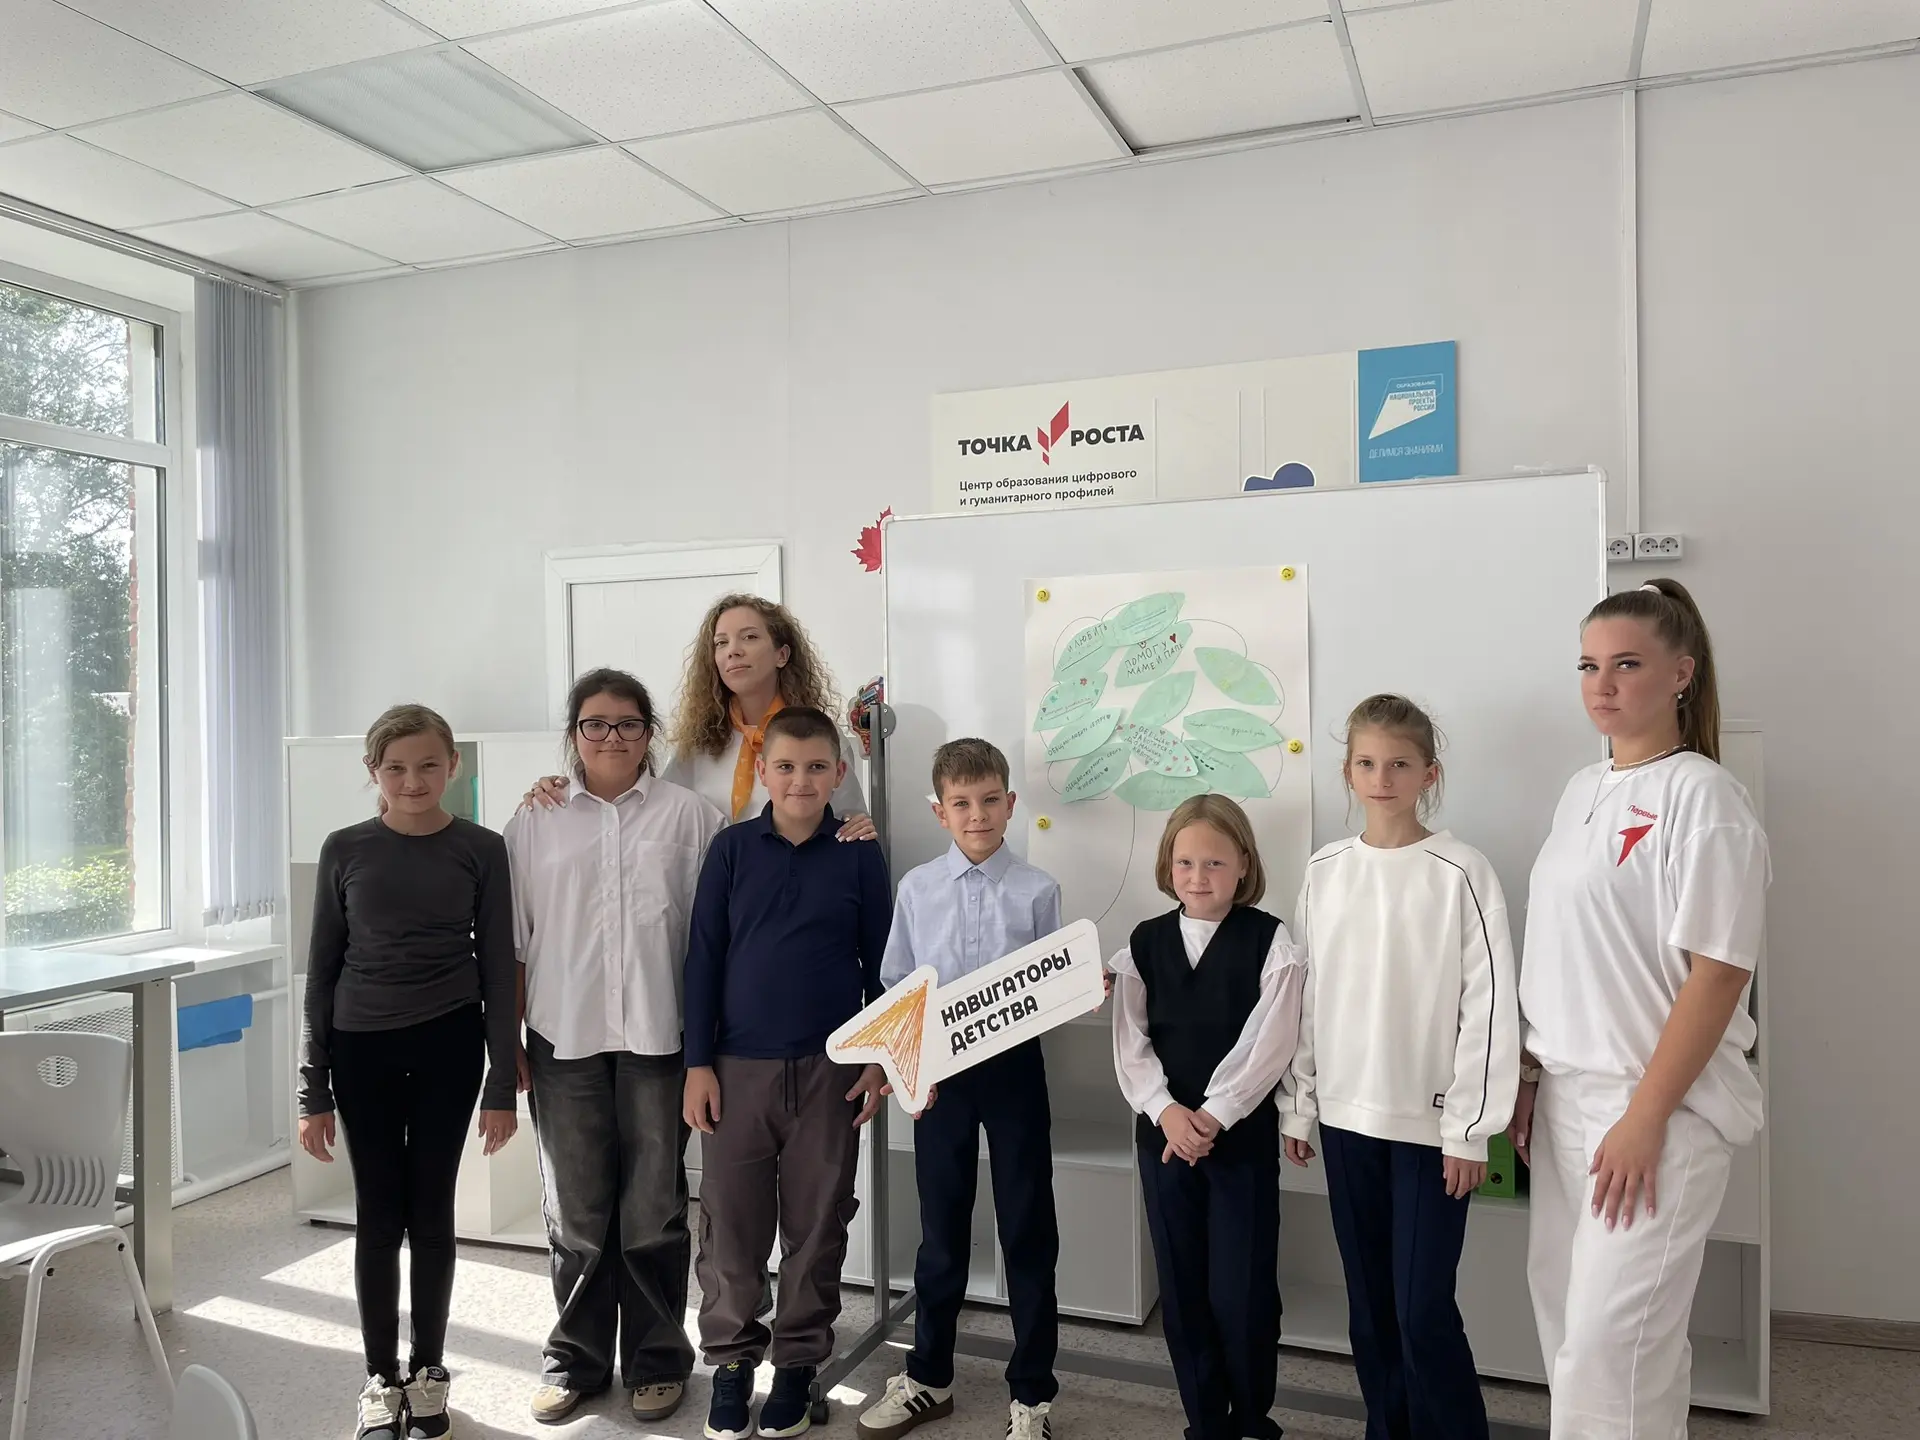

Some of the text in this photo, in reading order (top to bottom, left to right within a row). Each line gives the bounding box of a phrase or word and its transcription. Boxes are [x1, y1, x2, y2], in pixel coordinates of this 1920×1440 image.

[1409, 397, 1435, 405] ПРОЕКТЫ
[958, 424, 1145, 455] ТОЧКА РОСТА
[1369, 444, 1444, 459] ДЕЛИМСЯ ЗНАНИЯМИ
[960, 469, 1137, 492] Центр образования цифрового
[960, 486, 1114, 507] и гуманитарного профилей
[1073, 623, 1108, 647] ЛЮБИТЬ
[1124, 641, 1168, 668] ПОМОГУ
[1127, 663, 1156, 678] МАМЕ
[1157, 656, 1163, 665] И
[1627, 804, 1659, 820] Первые
[940, 947, 1072, 1027] НАВИГАТОРЫ
[950, 995, 1039, 1056] ДЕТСТВА
